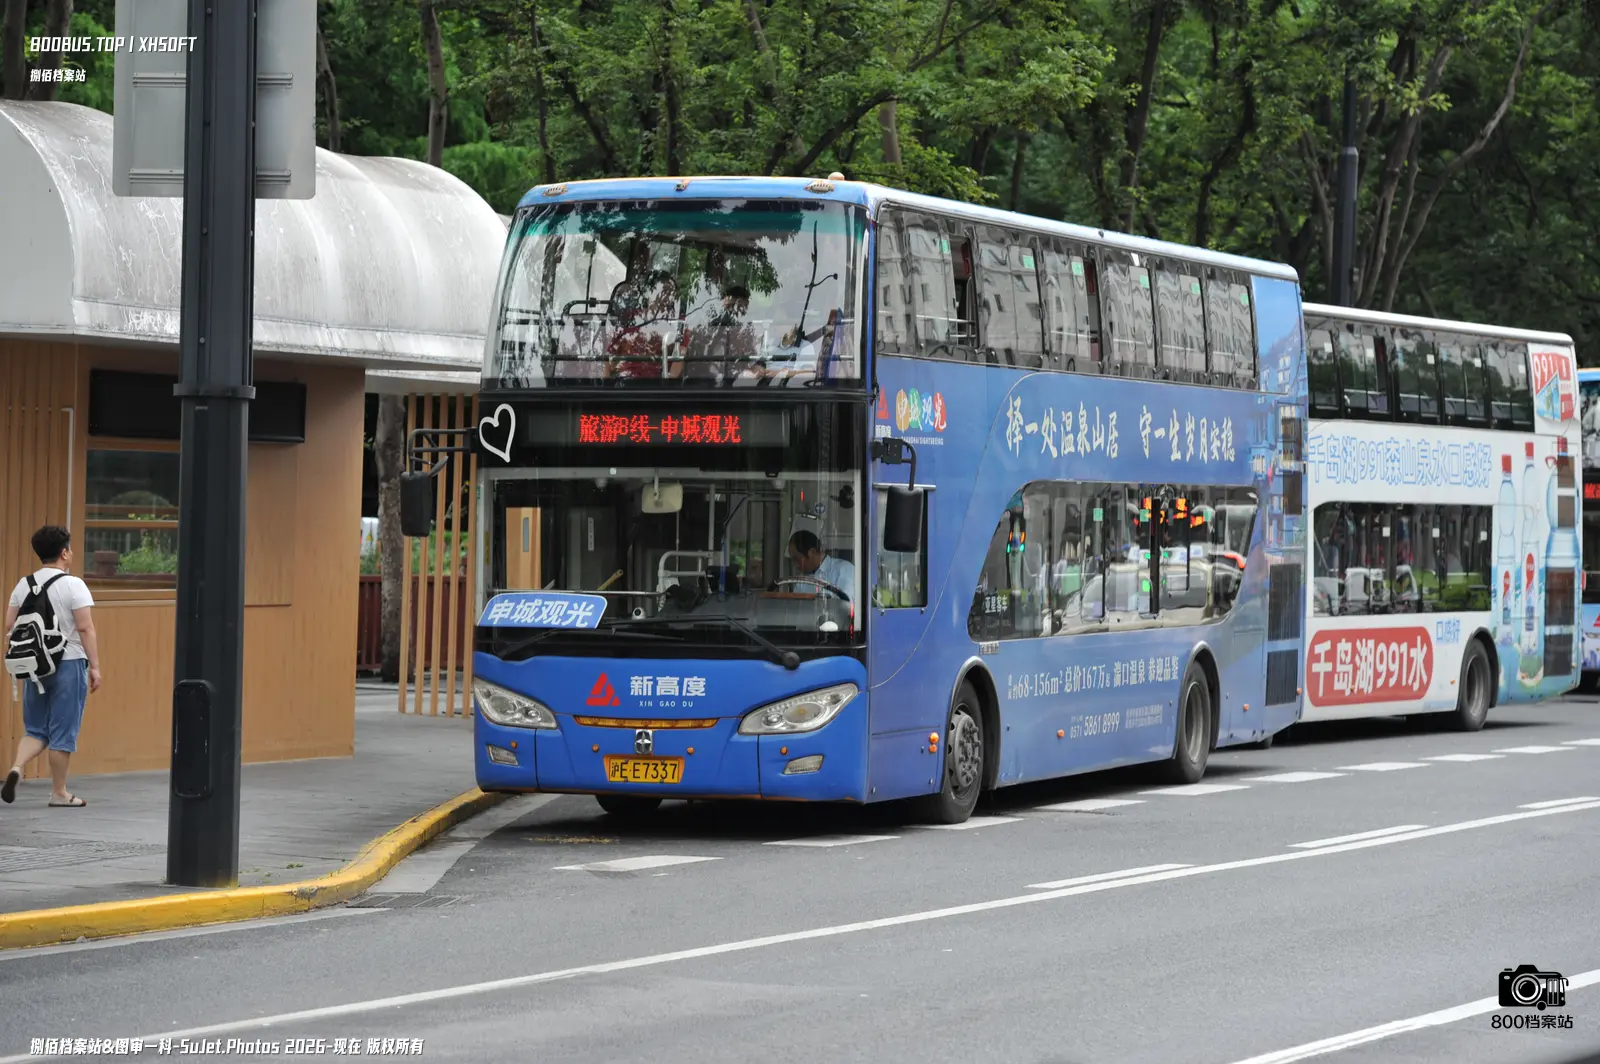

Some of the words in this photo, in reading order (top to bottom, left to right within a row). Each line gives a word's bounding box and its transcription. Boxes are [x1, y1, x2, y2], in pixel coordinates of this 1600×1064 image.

[895, 388, 947, 434] 申城观光
[1006, 395, 1119, 459] 择一处温泉山居
[1139, 404, 1236, 464] 守一生岁月安稳
[488, 599, 594, 627] 申城观光
[1312, 635, 1428, 697] 千岛湖991水
[630, 675, 706, 698] 新高度
[1084, 714, 1101, 736] 5861
[1102, 711, 1120, 733] 8999
